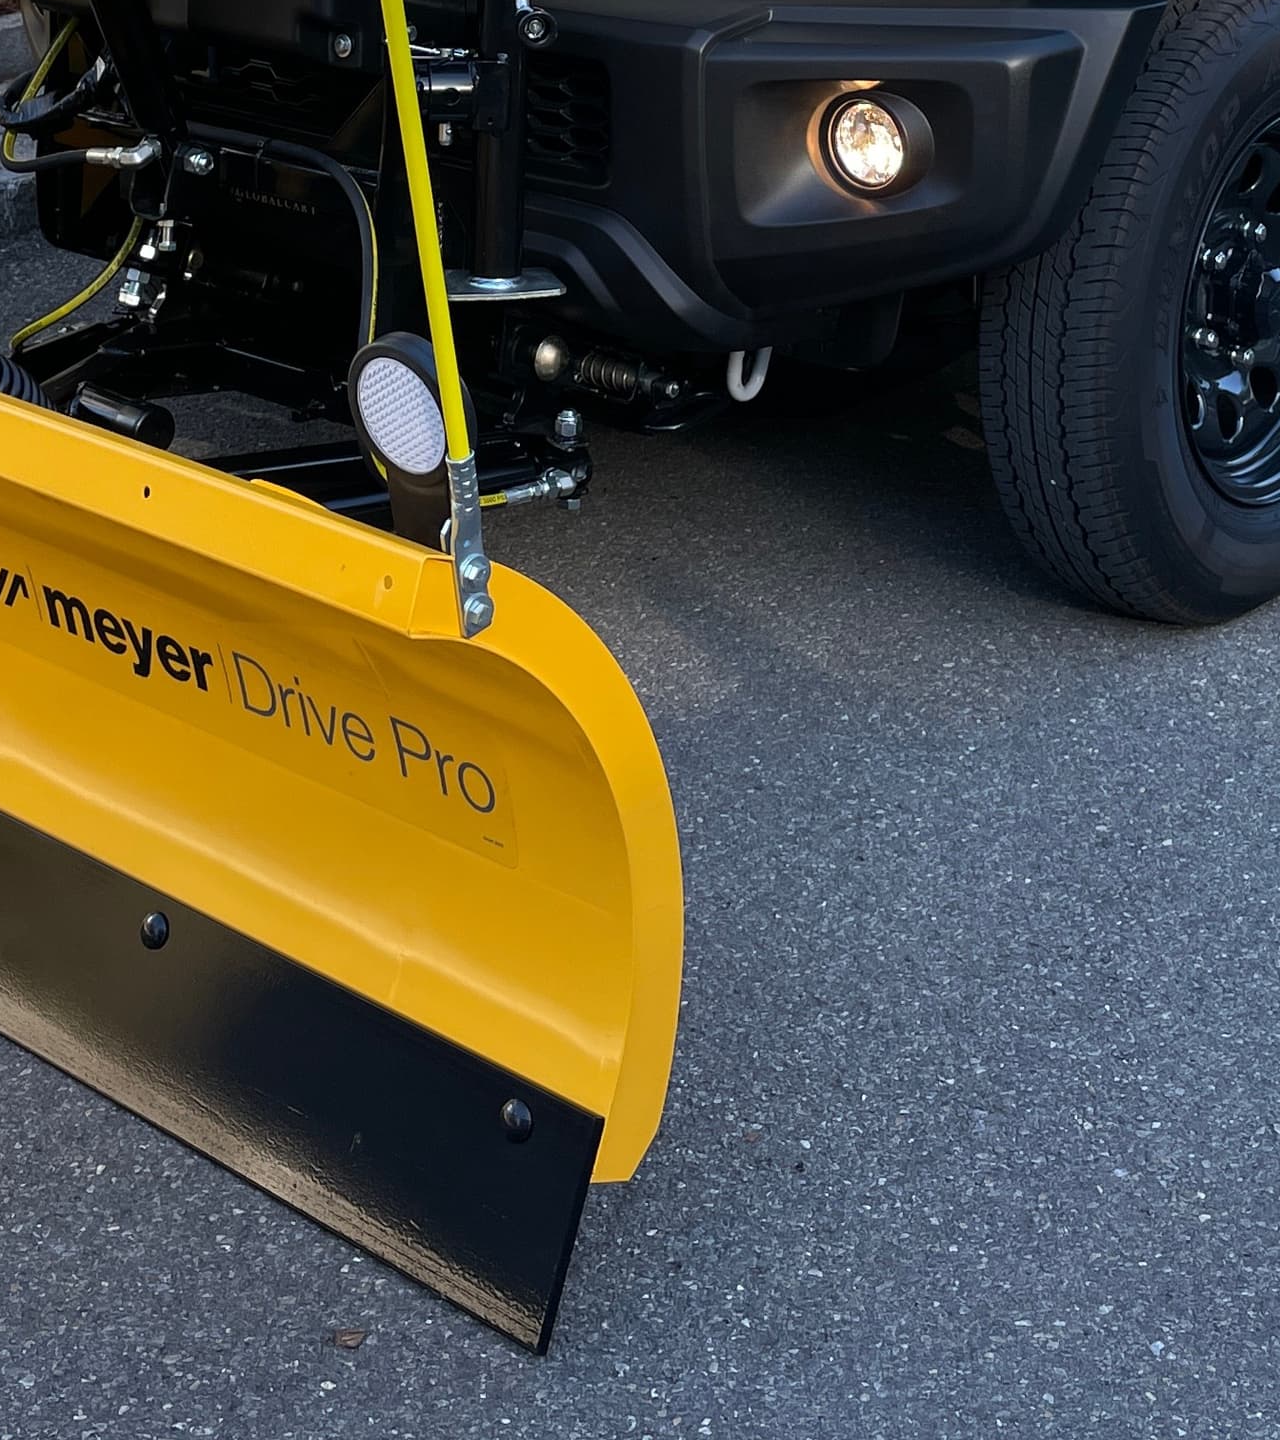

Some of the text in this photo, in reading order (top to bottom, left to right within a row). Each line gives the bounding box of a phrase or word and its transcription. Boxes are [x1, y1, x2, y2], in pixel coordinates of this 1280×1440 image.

[41, 584, 496, 814] meyer Drive Pro
